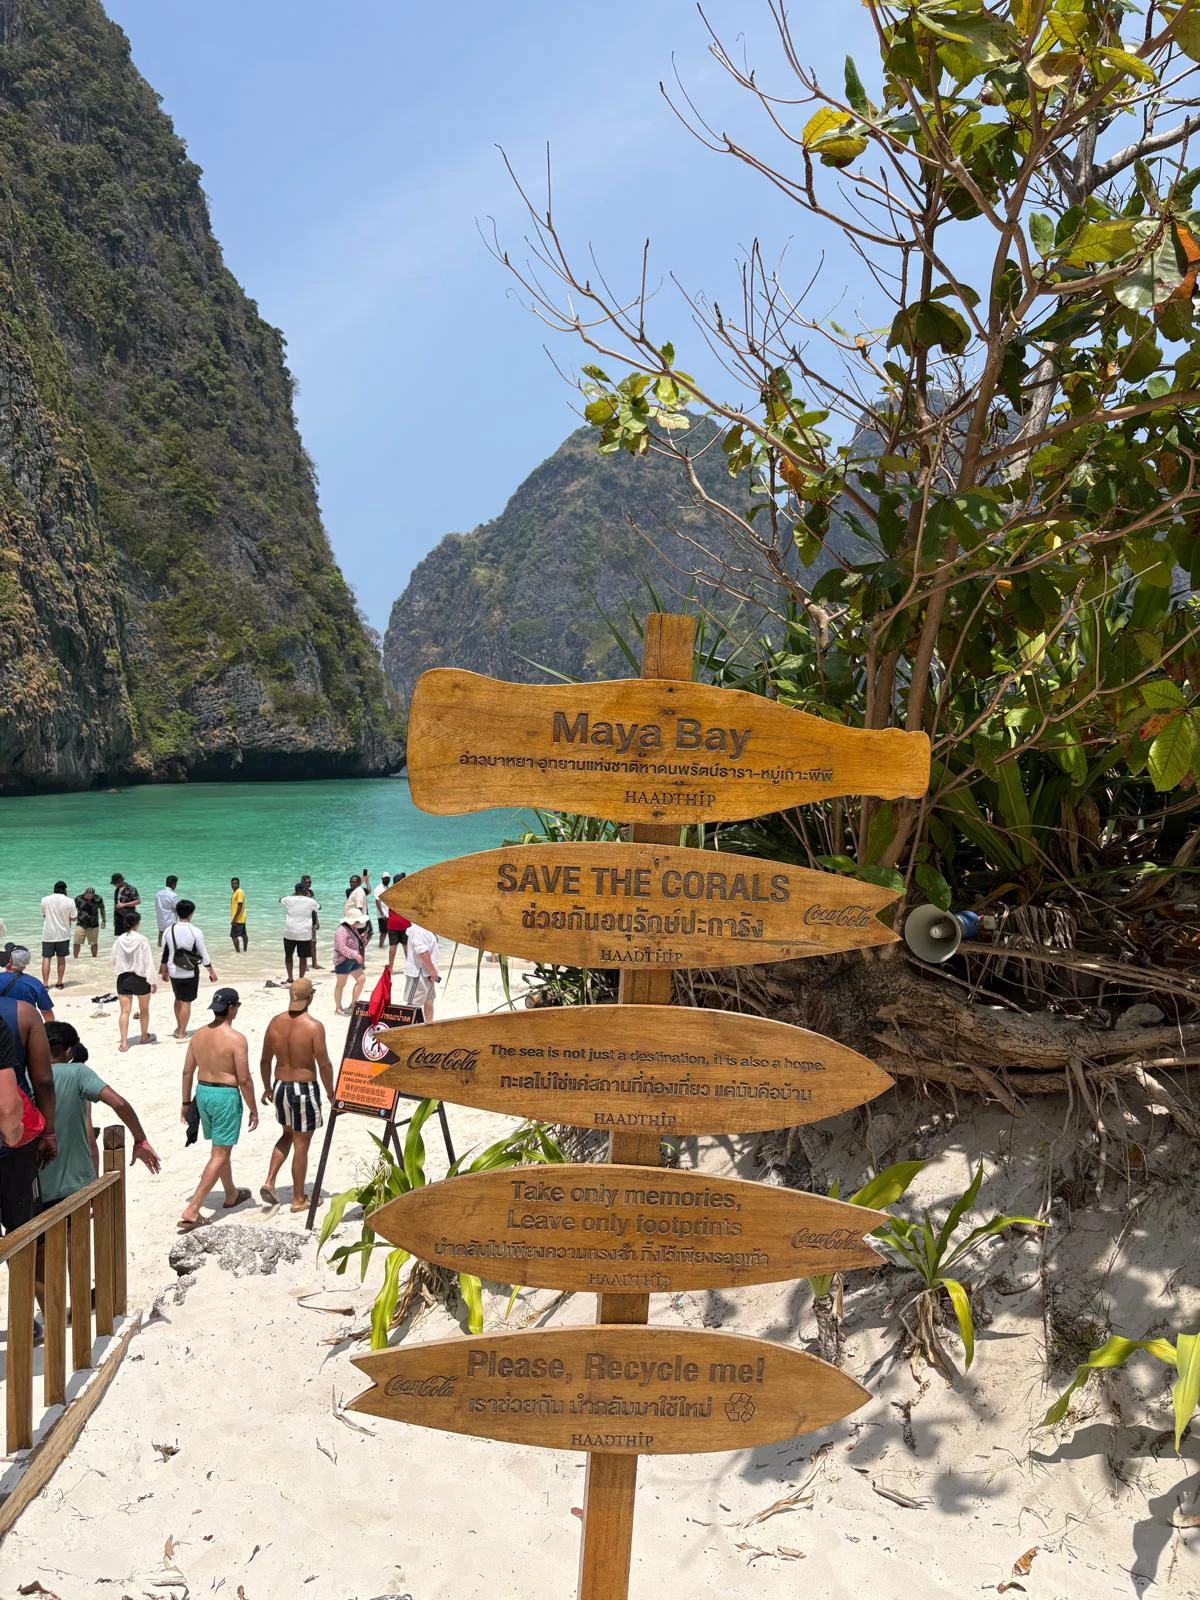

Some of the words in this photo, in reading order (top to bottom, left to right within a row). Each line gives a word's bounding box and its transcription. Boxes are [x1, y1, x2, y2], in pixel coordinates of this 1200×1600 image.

[553, 711, 662, 754] Maya
[675, 718, 751, 760] Bay
[497, 863, 581, 895] SAVE
[590, 867, 651, 898] THE
[661, 870, 790, 903] CORALS
[522, 903, 764, 941] ช่วยกันอนุรักษ์ปะการัง
[406, 1047, 481, 1072] Coca-Cola
[490, 1044, 515, 1056] The
[519, 1047, 544, 1058] sea
[548, 1046, 559, 1058] is
[563, 1047, 586, 1059] not
[587, 1049, 614, 1062] just
[617, 1052, 626, 1060] a
[629, 1050, 709, 1066] destination,
[740, 1056, 769, 1069] also
[772, 1060, 781, 1069] a
[784, 1058, 826, 1071] home.
[714, 1080, 812, 1102] แต่มันคือบ้าน
[511, 1180, 564, 1202] Take
[570, 1184, 619, 1208] only
[624, 1187, 742, 1212] memories,
[507, 1209, 577, 1231] Leave
[581, 1213, 630, 1237] only
[636, 1213, 743, 1238] footprints
[467, 1350, 572, 1384] Please,
[584, 1353, 699, 1387] Recycle
[709, 1357, 765, 1385] me!
[468, 1392, 564, 1415] เราช่วยกัน
[569, 1393, 713, 1418] นำกลับมาใช้ใหม่
